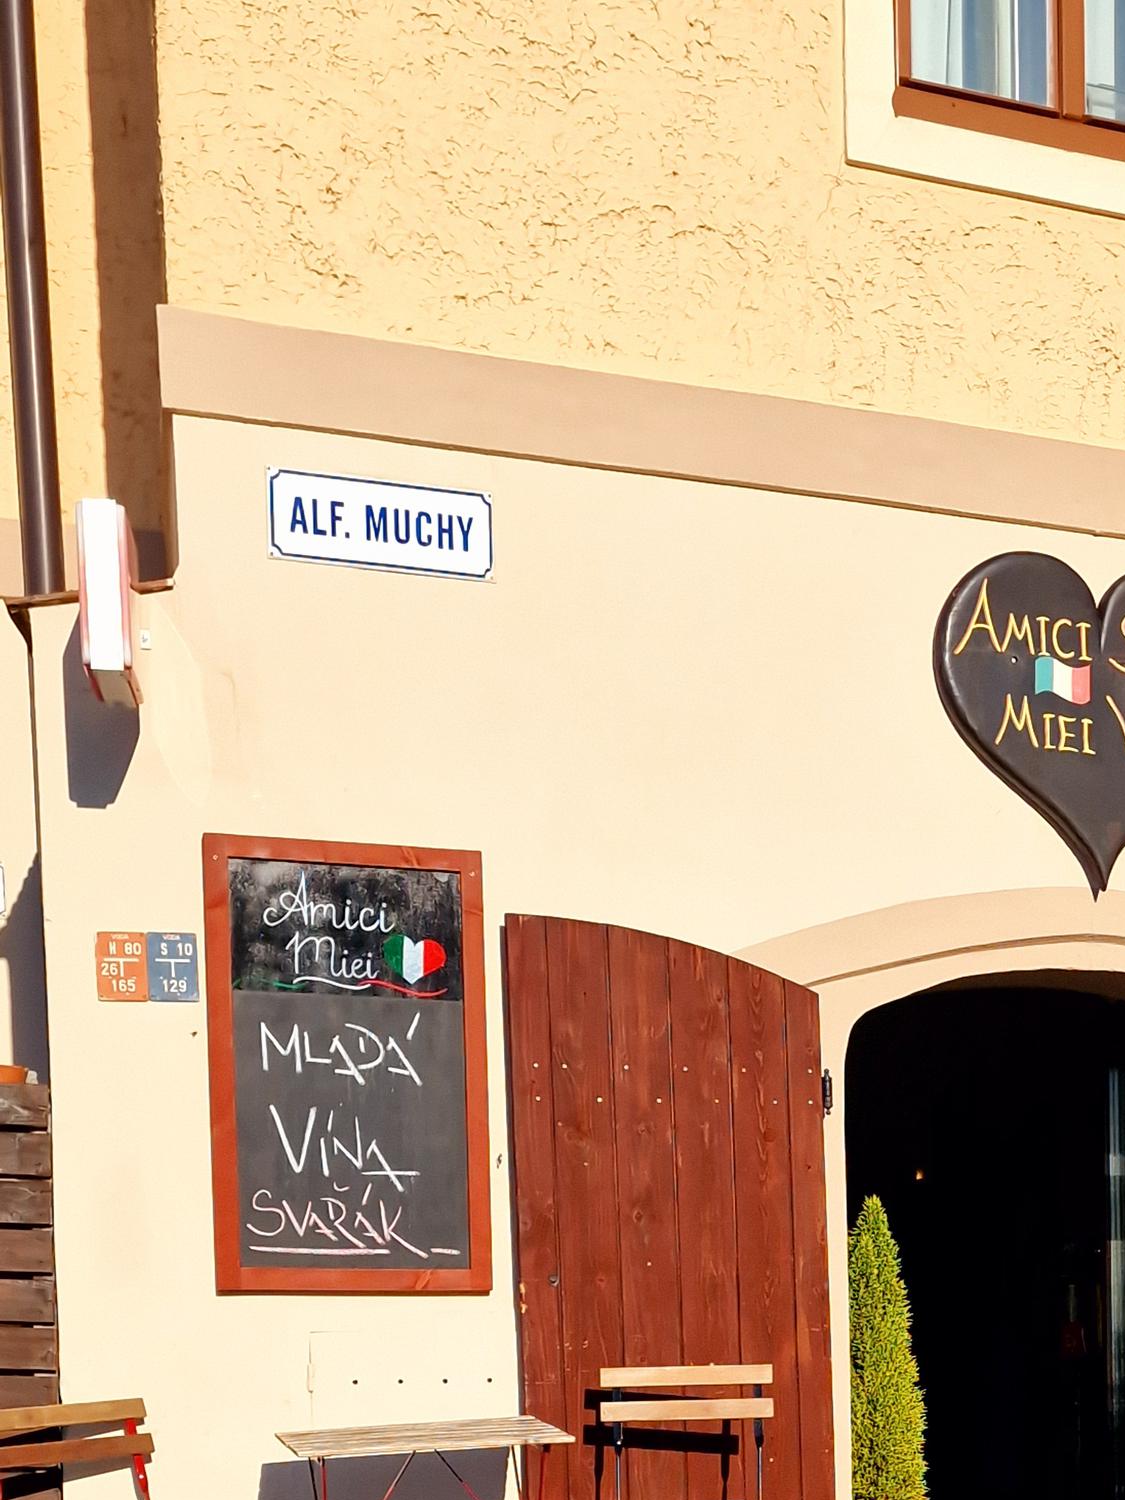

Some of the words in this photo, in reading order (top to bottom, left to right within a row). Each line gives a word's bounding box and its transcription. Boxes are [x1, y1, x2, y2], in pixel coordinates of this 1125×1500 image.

[290, 496, 350, 538] ALF.
[365, 504, 474, 552] MUCHY
[953, 577, 1093, 661] AMICI
[994, 693, 1097, 755] MIEI
[262, 869, 396, 933] Amici
[123, 942, 142, 956] 80
[160, 942, 168, 956] S
[177, 942, 193, 957] 10
[285, 931, 379, 979] Miei
